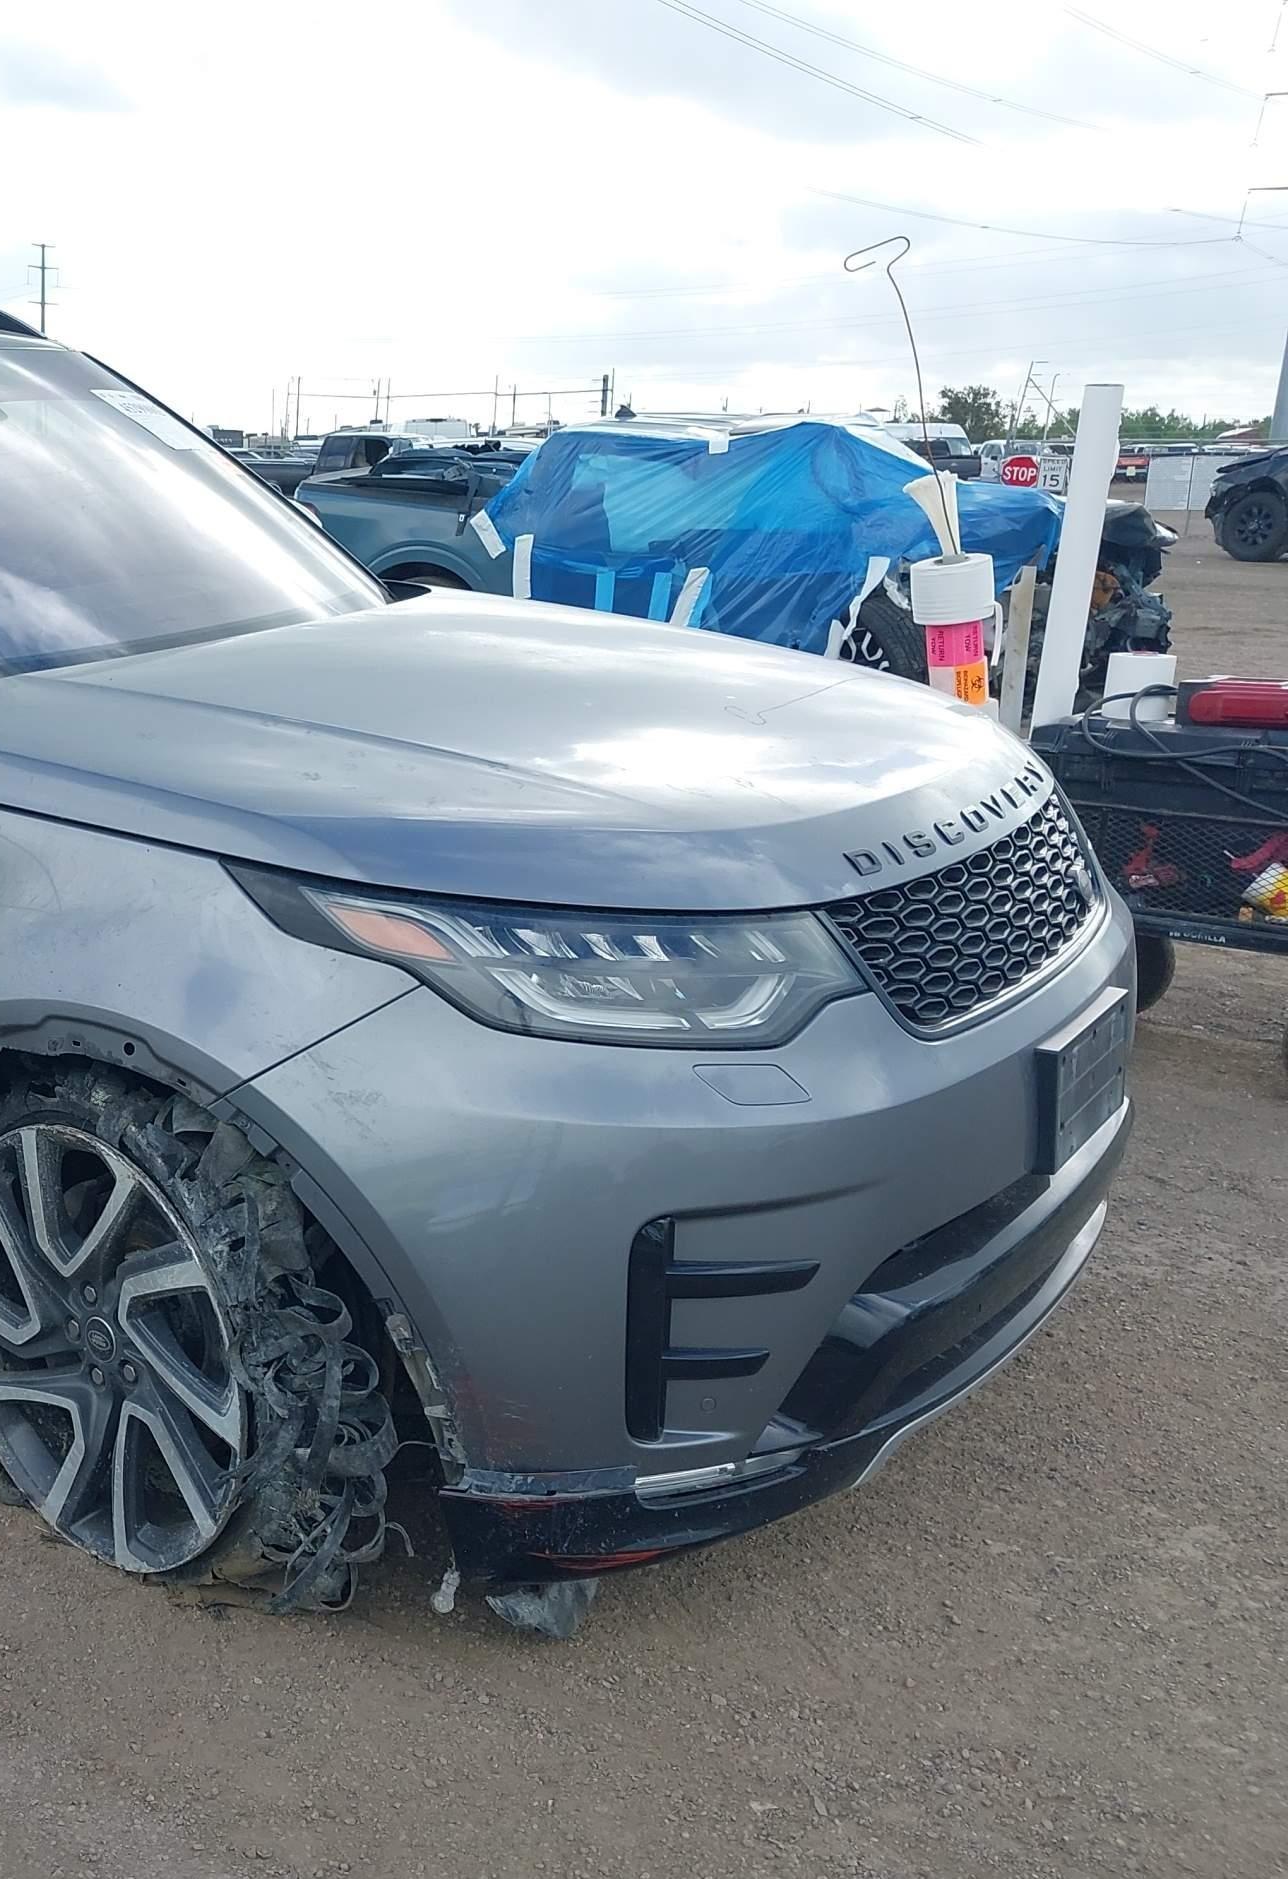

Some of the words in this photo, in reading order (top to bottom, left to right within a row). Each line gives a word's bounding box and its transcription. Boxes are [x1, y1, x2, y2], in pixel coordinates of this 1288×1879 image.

[1003, 466, 1037, 482] STOP
[1043, 474, 1060, 487] 15
[937, 630, 945, 662] RETURN
[964, 634, 972, 652] TOW
[843, 760, 1045, 877] DISCOVERY
